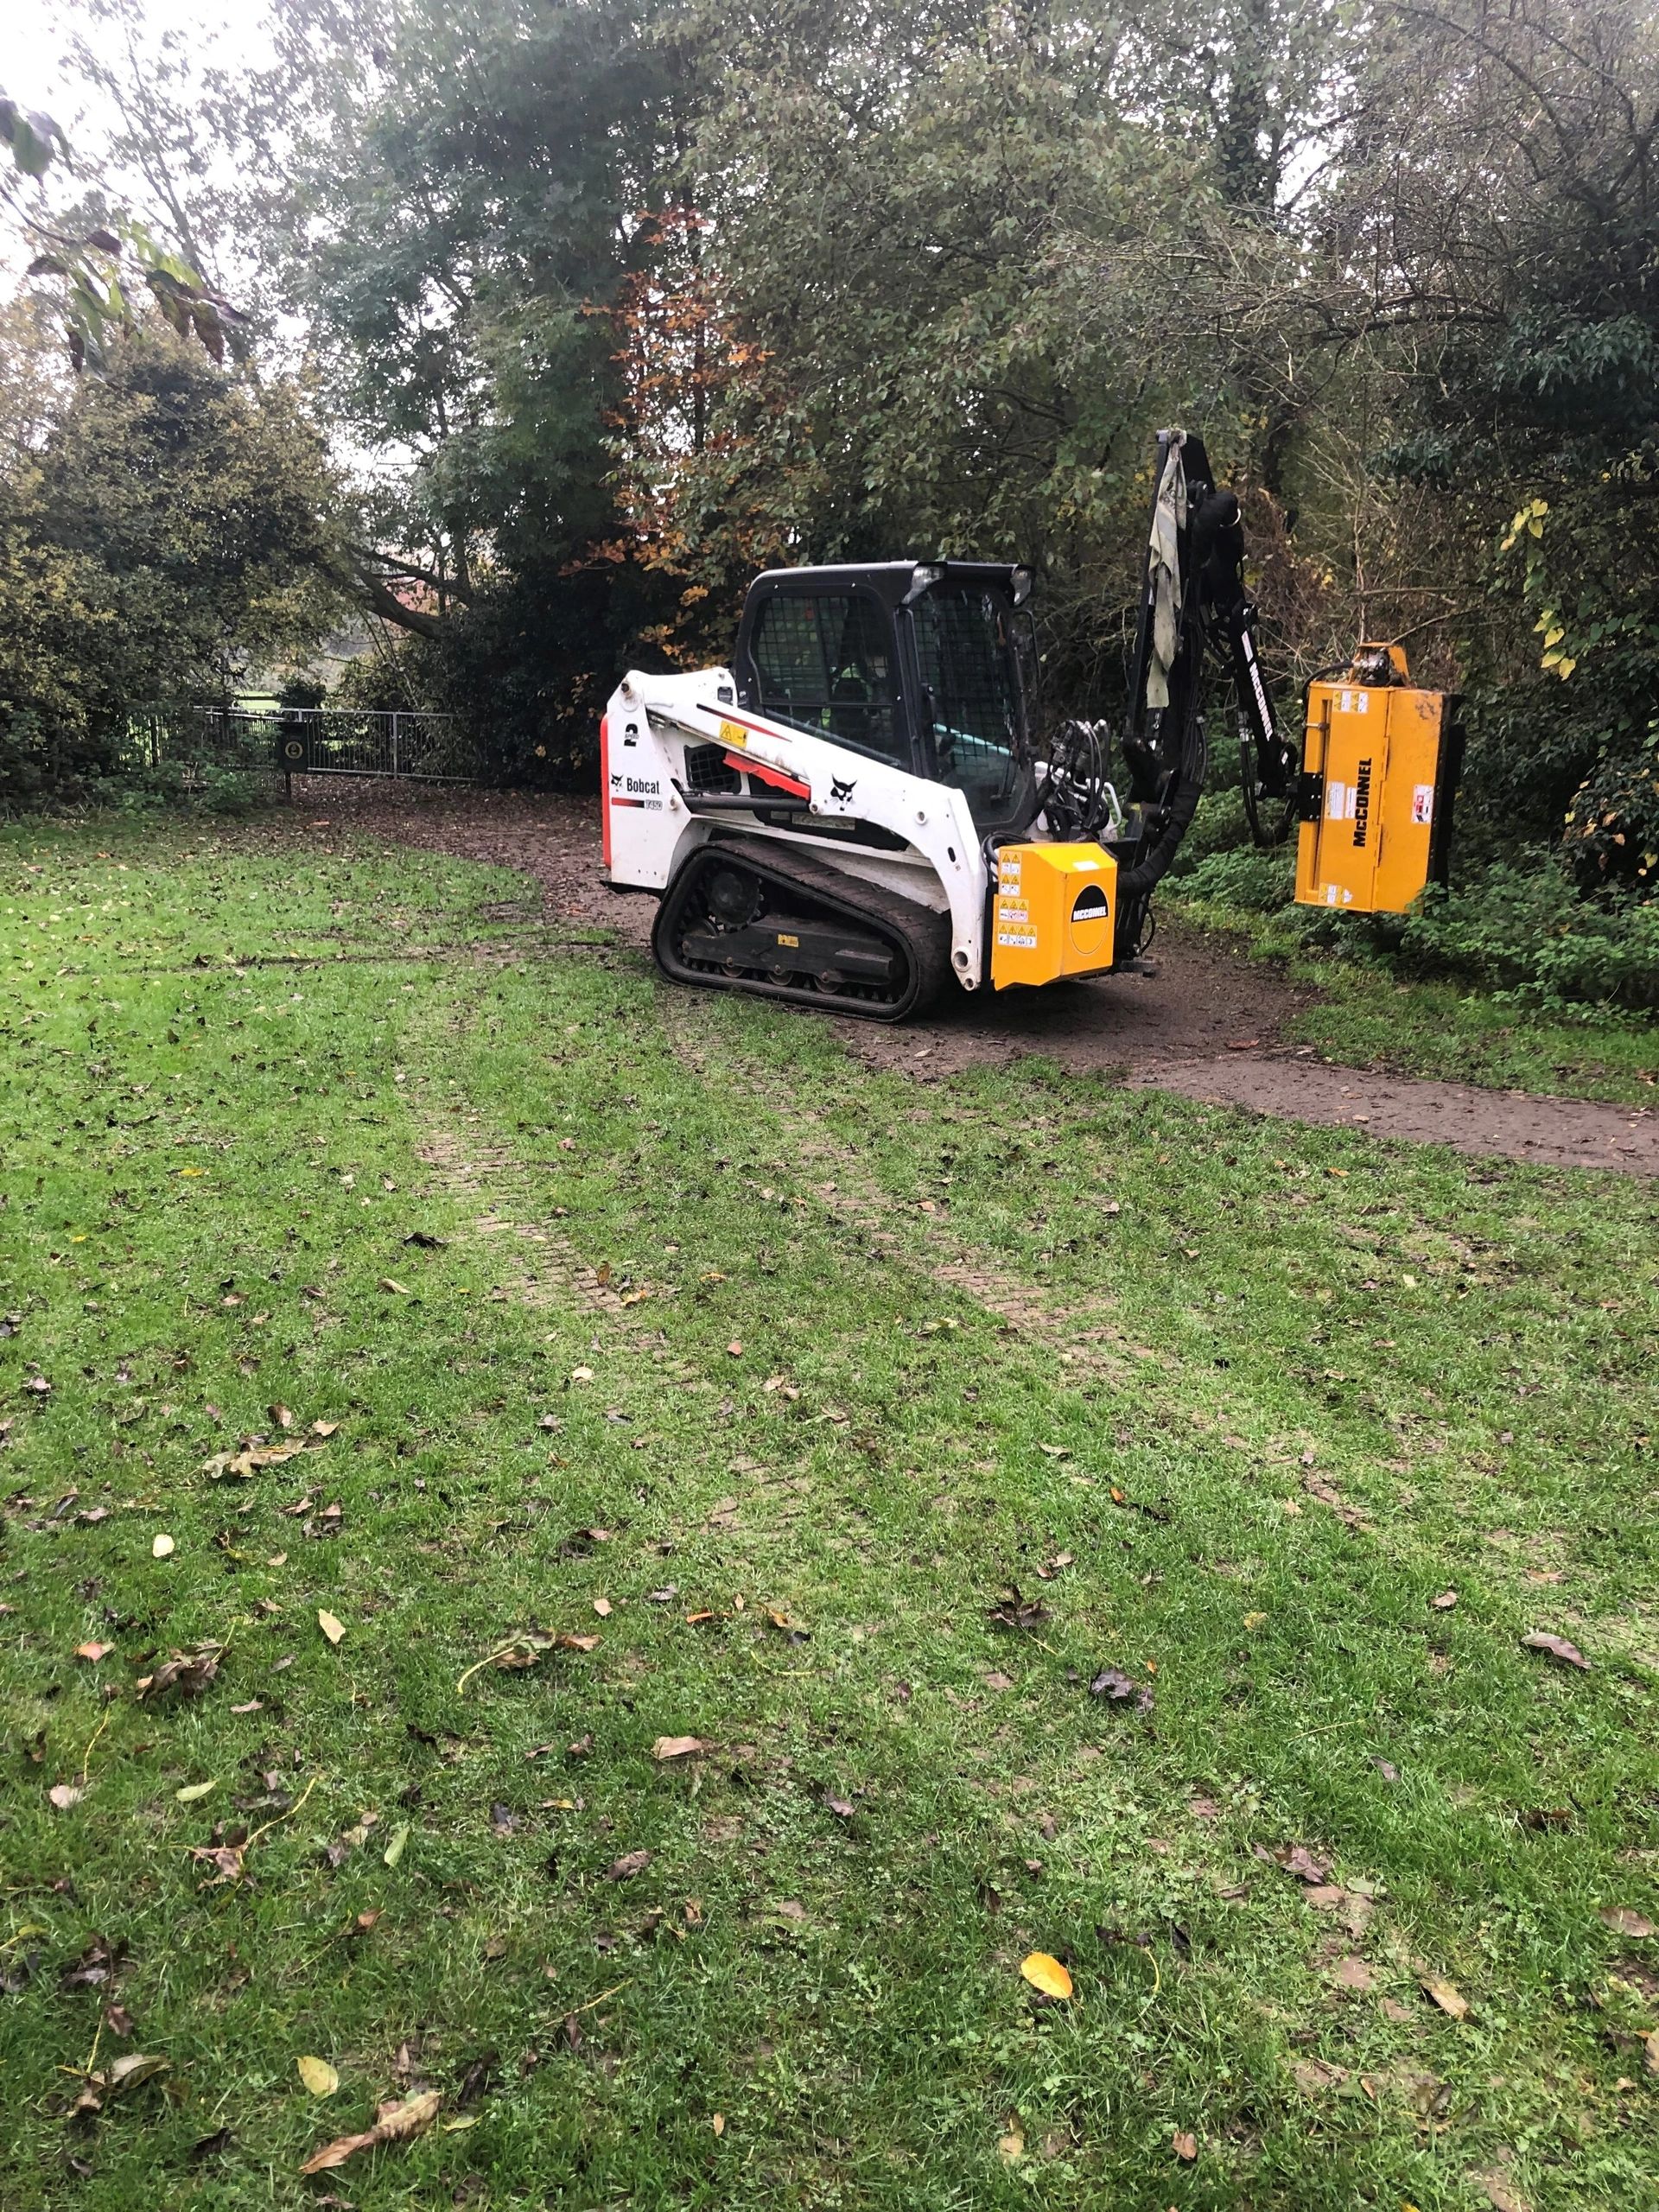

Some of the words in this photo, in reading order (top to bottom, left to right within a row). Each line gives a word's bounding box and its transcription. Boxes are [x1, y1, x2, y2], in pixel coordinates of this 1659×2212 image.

[624, 723, 639, 747] 2
[626, 778, 659, 795] Bobcat
[1353, 758, 1372, 847] McCONNEL
